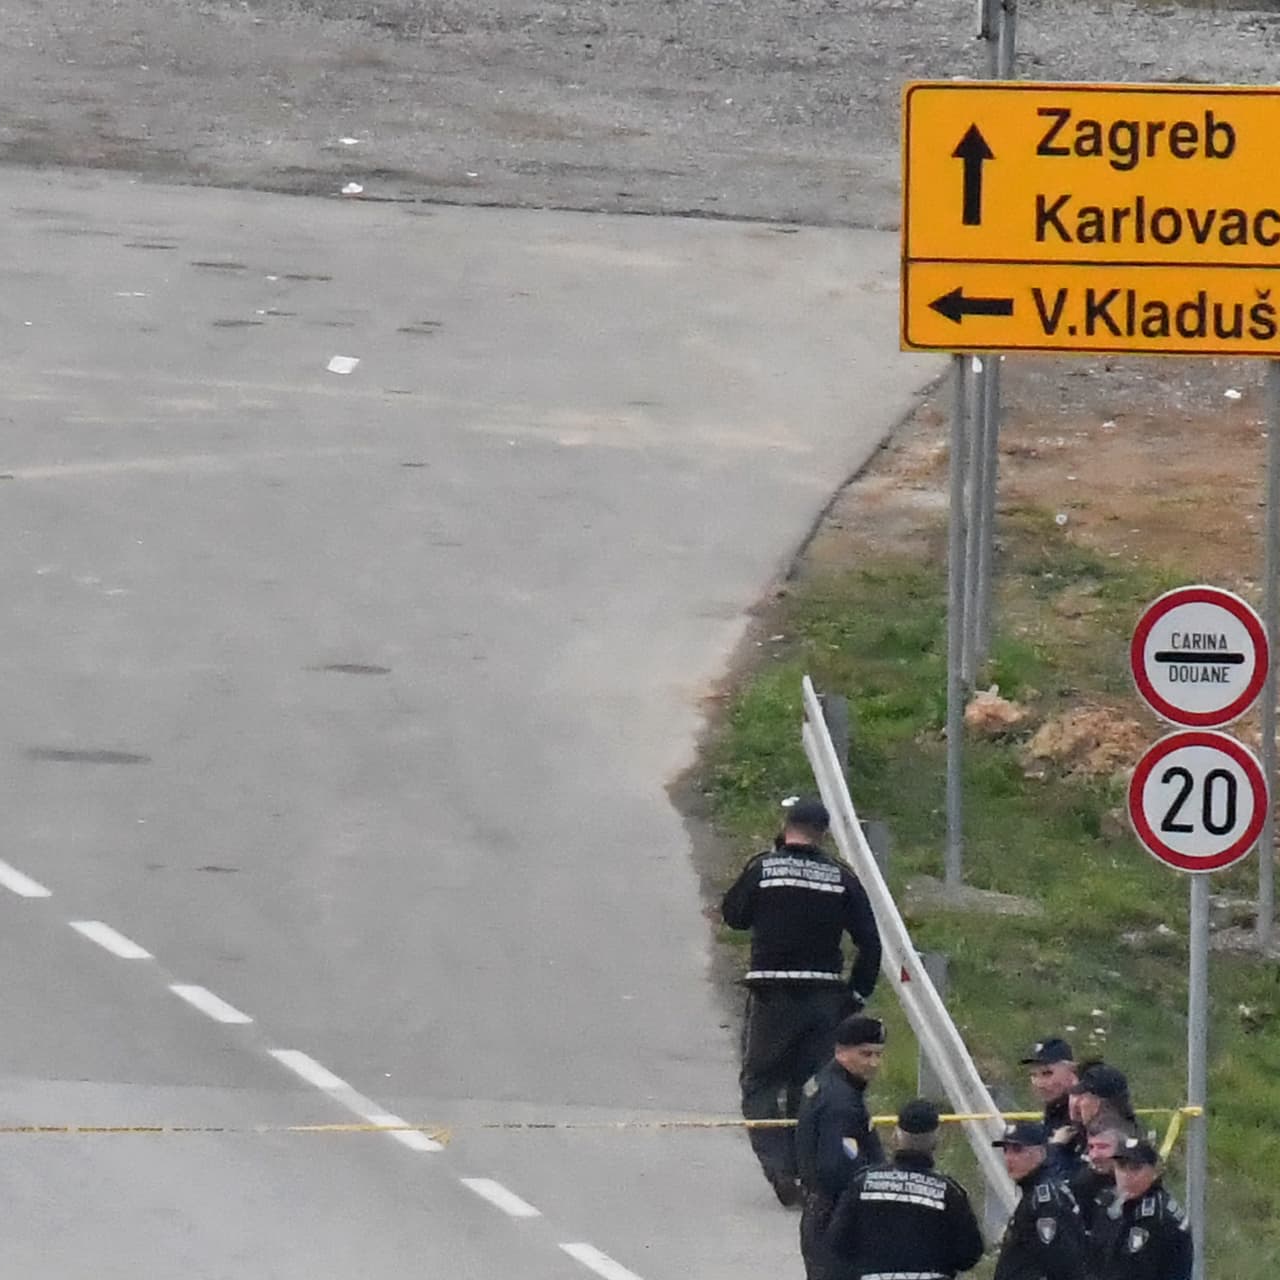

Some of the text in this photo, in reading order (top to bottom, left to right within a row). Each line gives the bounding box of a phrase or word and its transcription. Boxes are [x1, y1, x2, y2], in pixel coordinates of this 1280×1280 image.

[1036, 107, 1236, 171] Zagreb
[1171, 631, 1228, 650] CARINA
[1168, 664, 1231, 683] DOUANE
[1161, 766, 1238, 836] 20
